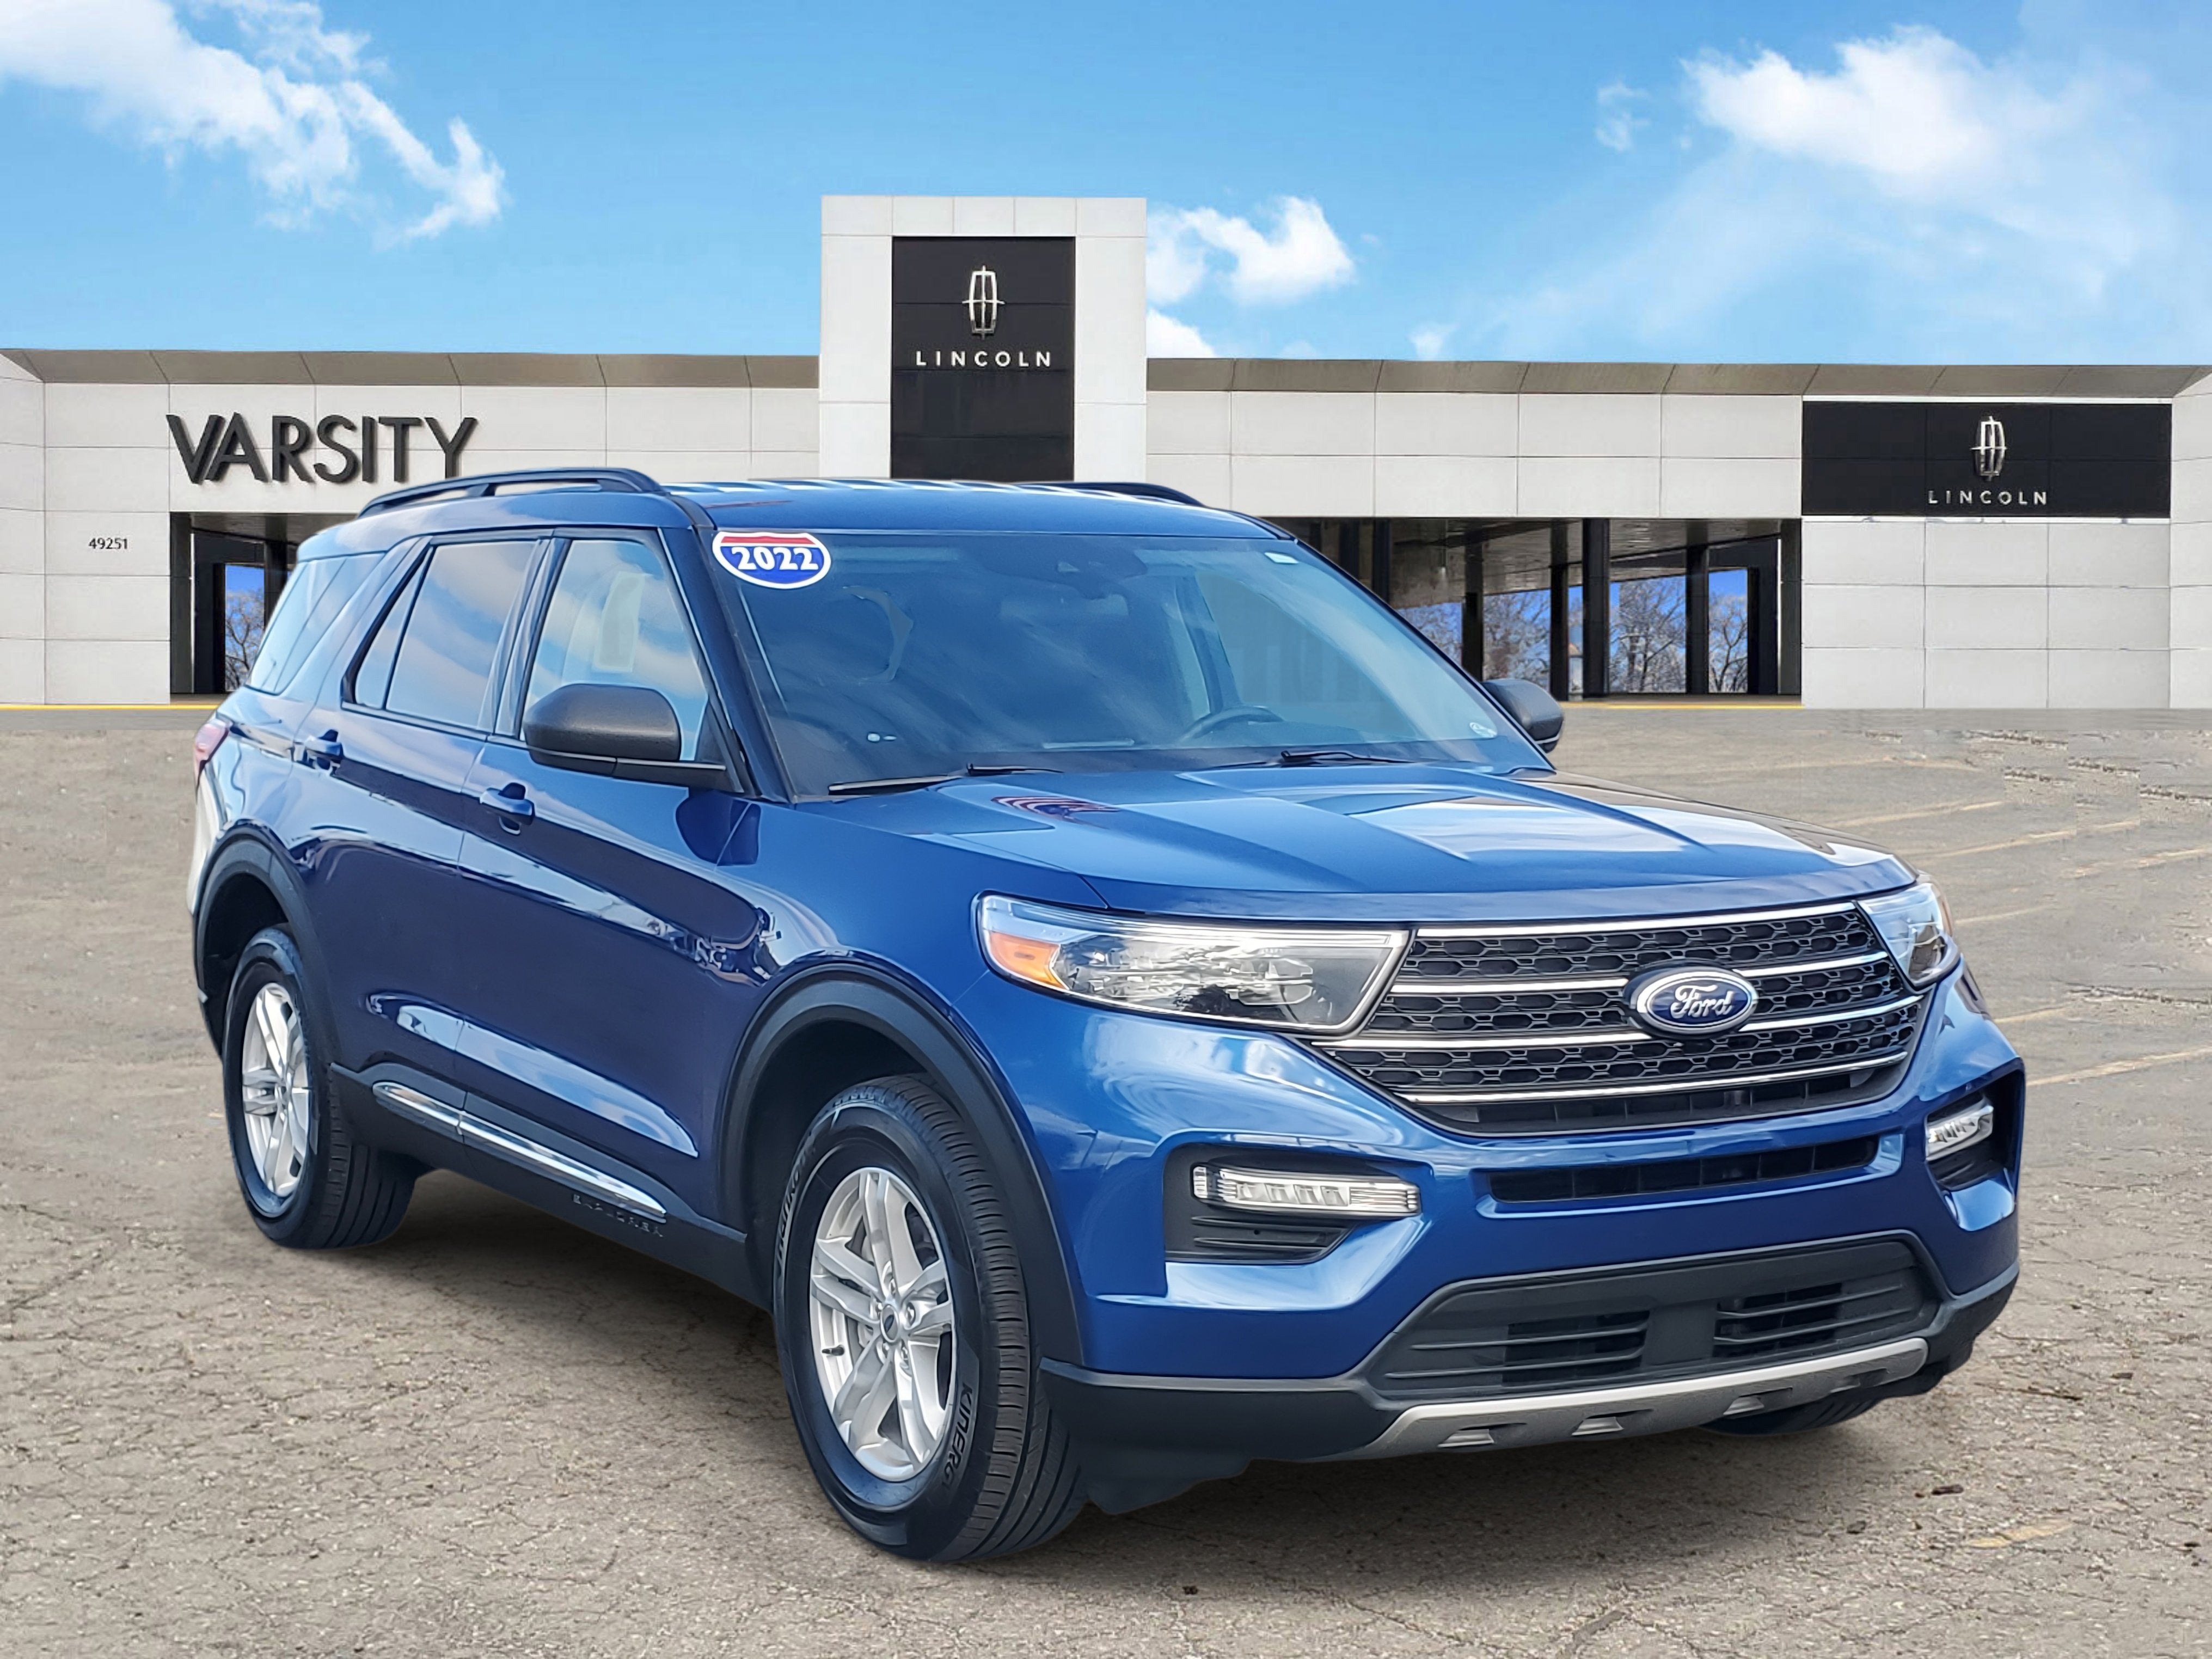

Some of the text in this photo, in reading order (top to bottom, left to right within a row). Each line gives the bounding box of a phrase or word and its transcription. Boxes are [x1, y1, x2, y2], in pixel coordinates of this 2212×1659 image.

[916, 350, 1051, 368] LINCOLN
[166, 411, 478, 485] VARSITY
[1928, 490, 2047, 505] LINCOLN
[88, 537, 128, 549] 49251
[731, 546, 819, 570] 2022
[1670, 984, 1736, 1019] Ford
[941, 1381, 973, 1491] KINERG
